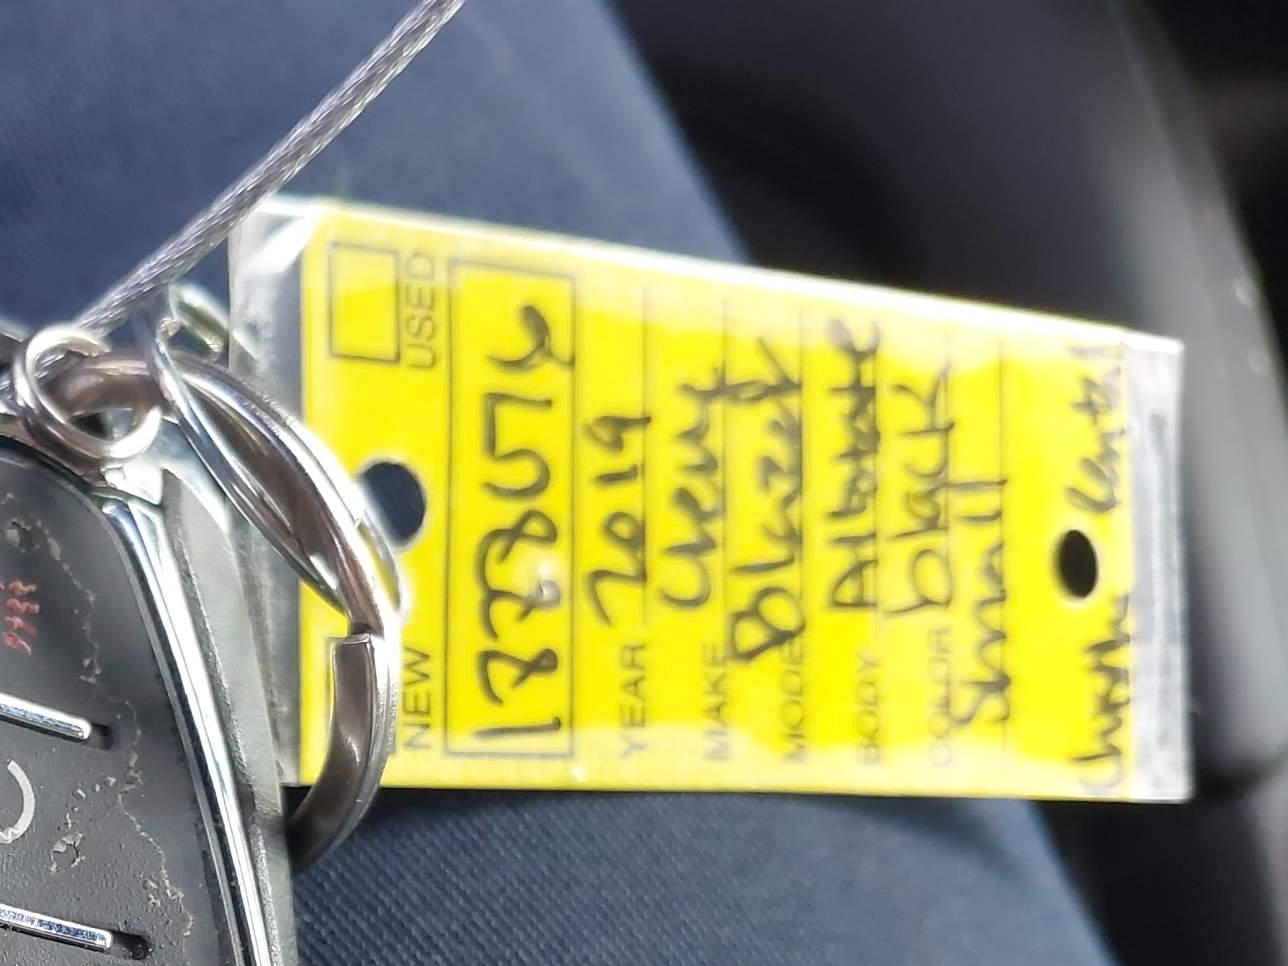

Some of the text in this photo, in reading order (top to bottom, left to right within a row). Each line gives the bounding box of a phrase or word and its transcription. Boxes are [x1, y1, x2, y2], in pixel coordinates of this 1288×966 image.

[404, 251, 437, 370] USED
[583, 412, 651, 627] 2019
[403, 645, 432, 750] NEW
[622, 642, 646, 758] YEAR
[704, 642, 727, 762] MAKE
[780, 624, 805, 765] MODE
[854, 653, 880, 765] BODY
[926, 627, 952, 767] COLOR
